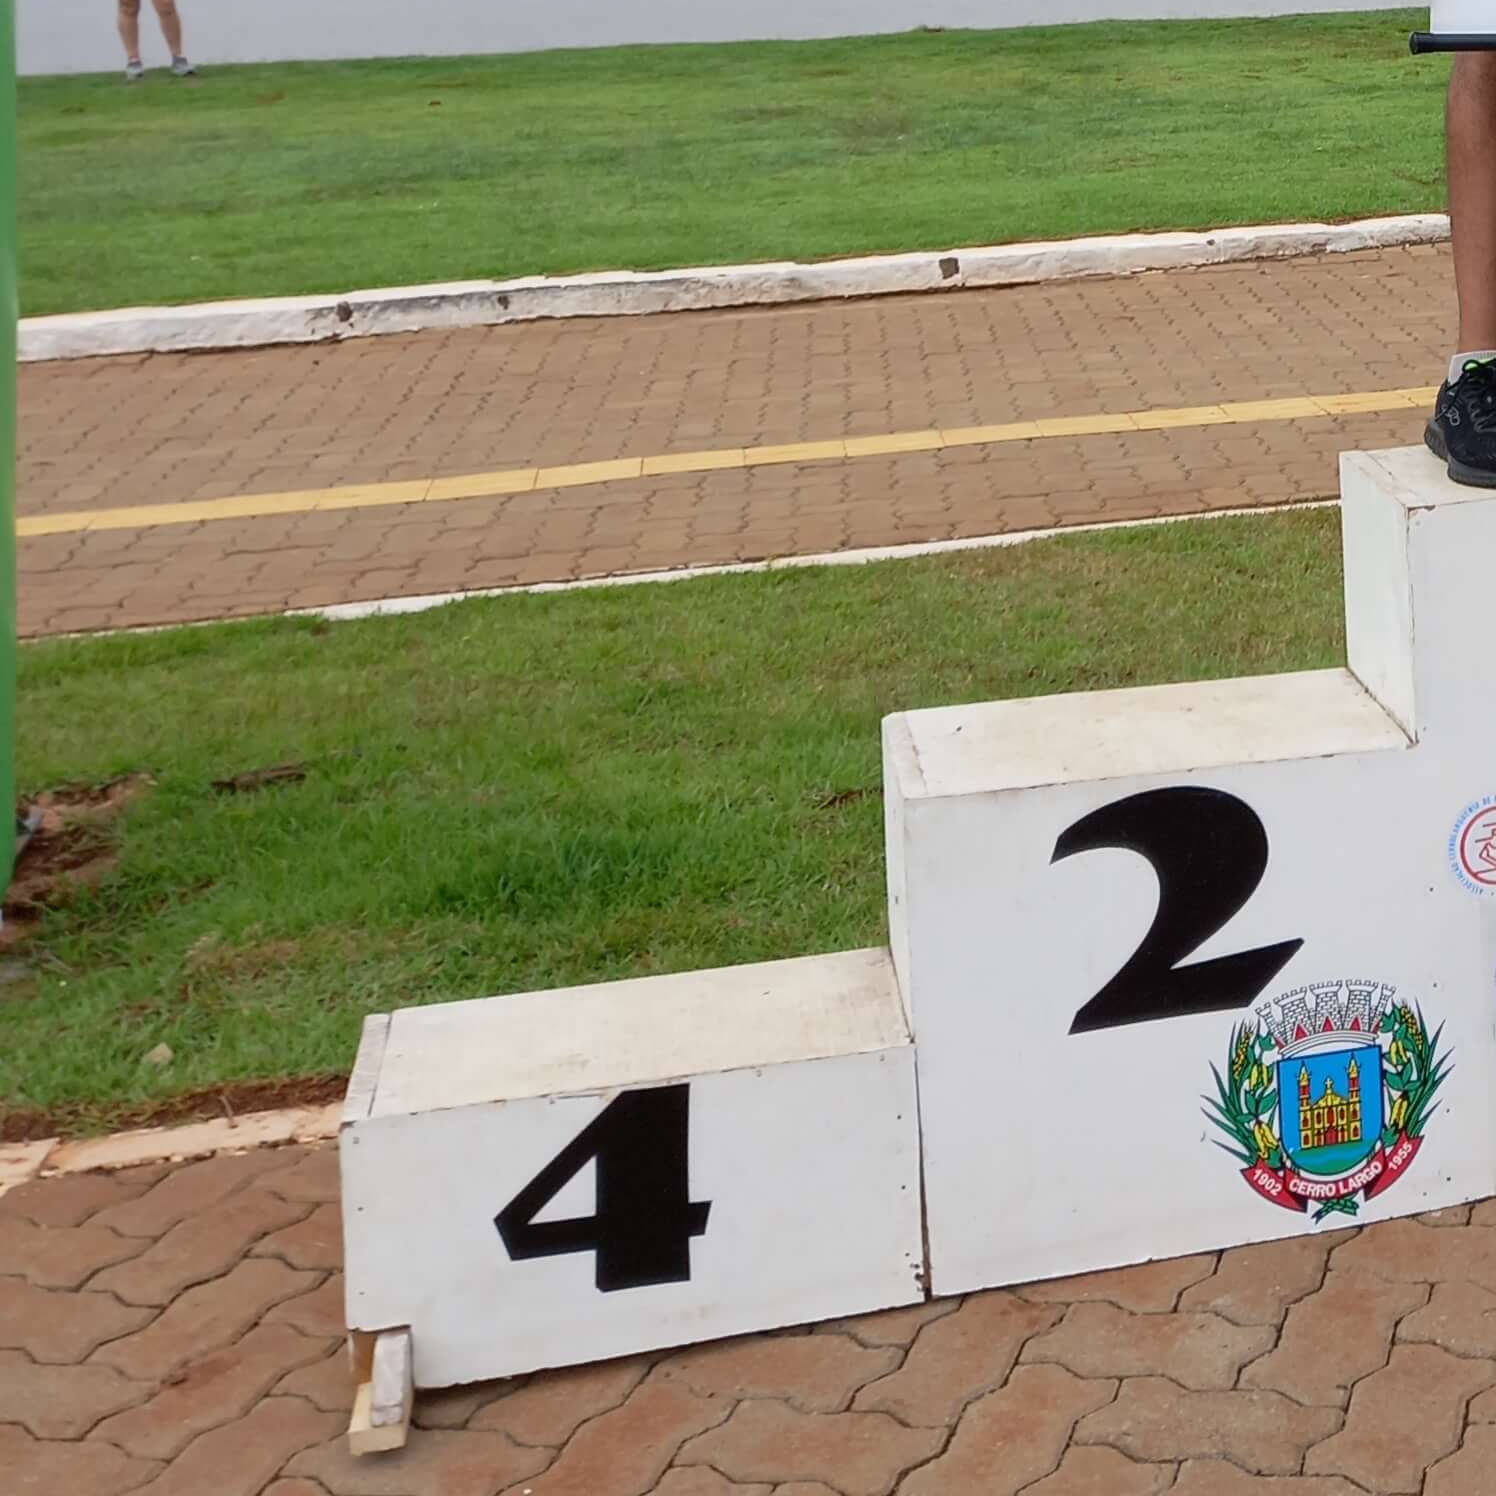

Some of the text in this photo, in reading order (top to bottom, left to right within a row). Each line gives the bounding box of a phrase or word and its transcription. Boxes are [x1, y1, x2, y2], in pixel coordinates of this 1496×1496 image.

[1050, 785, 1305, 1035] 2
[494, 1082, 713, 1293] 4
[1253, 1142, 1413, 1198] 1902 CERRO LARGO 1955
